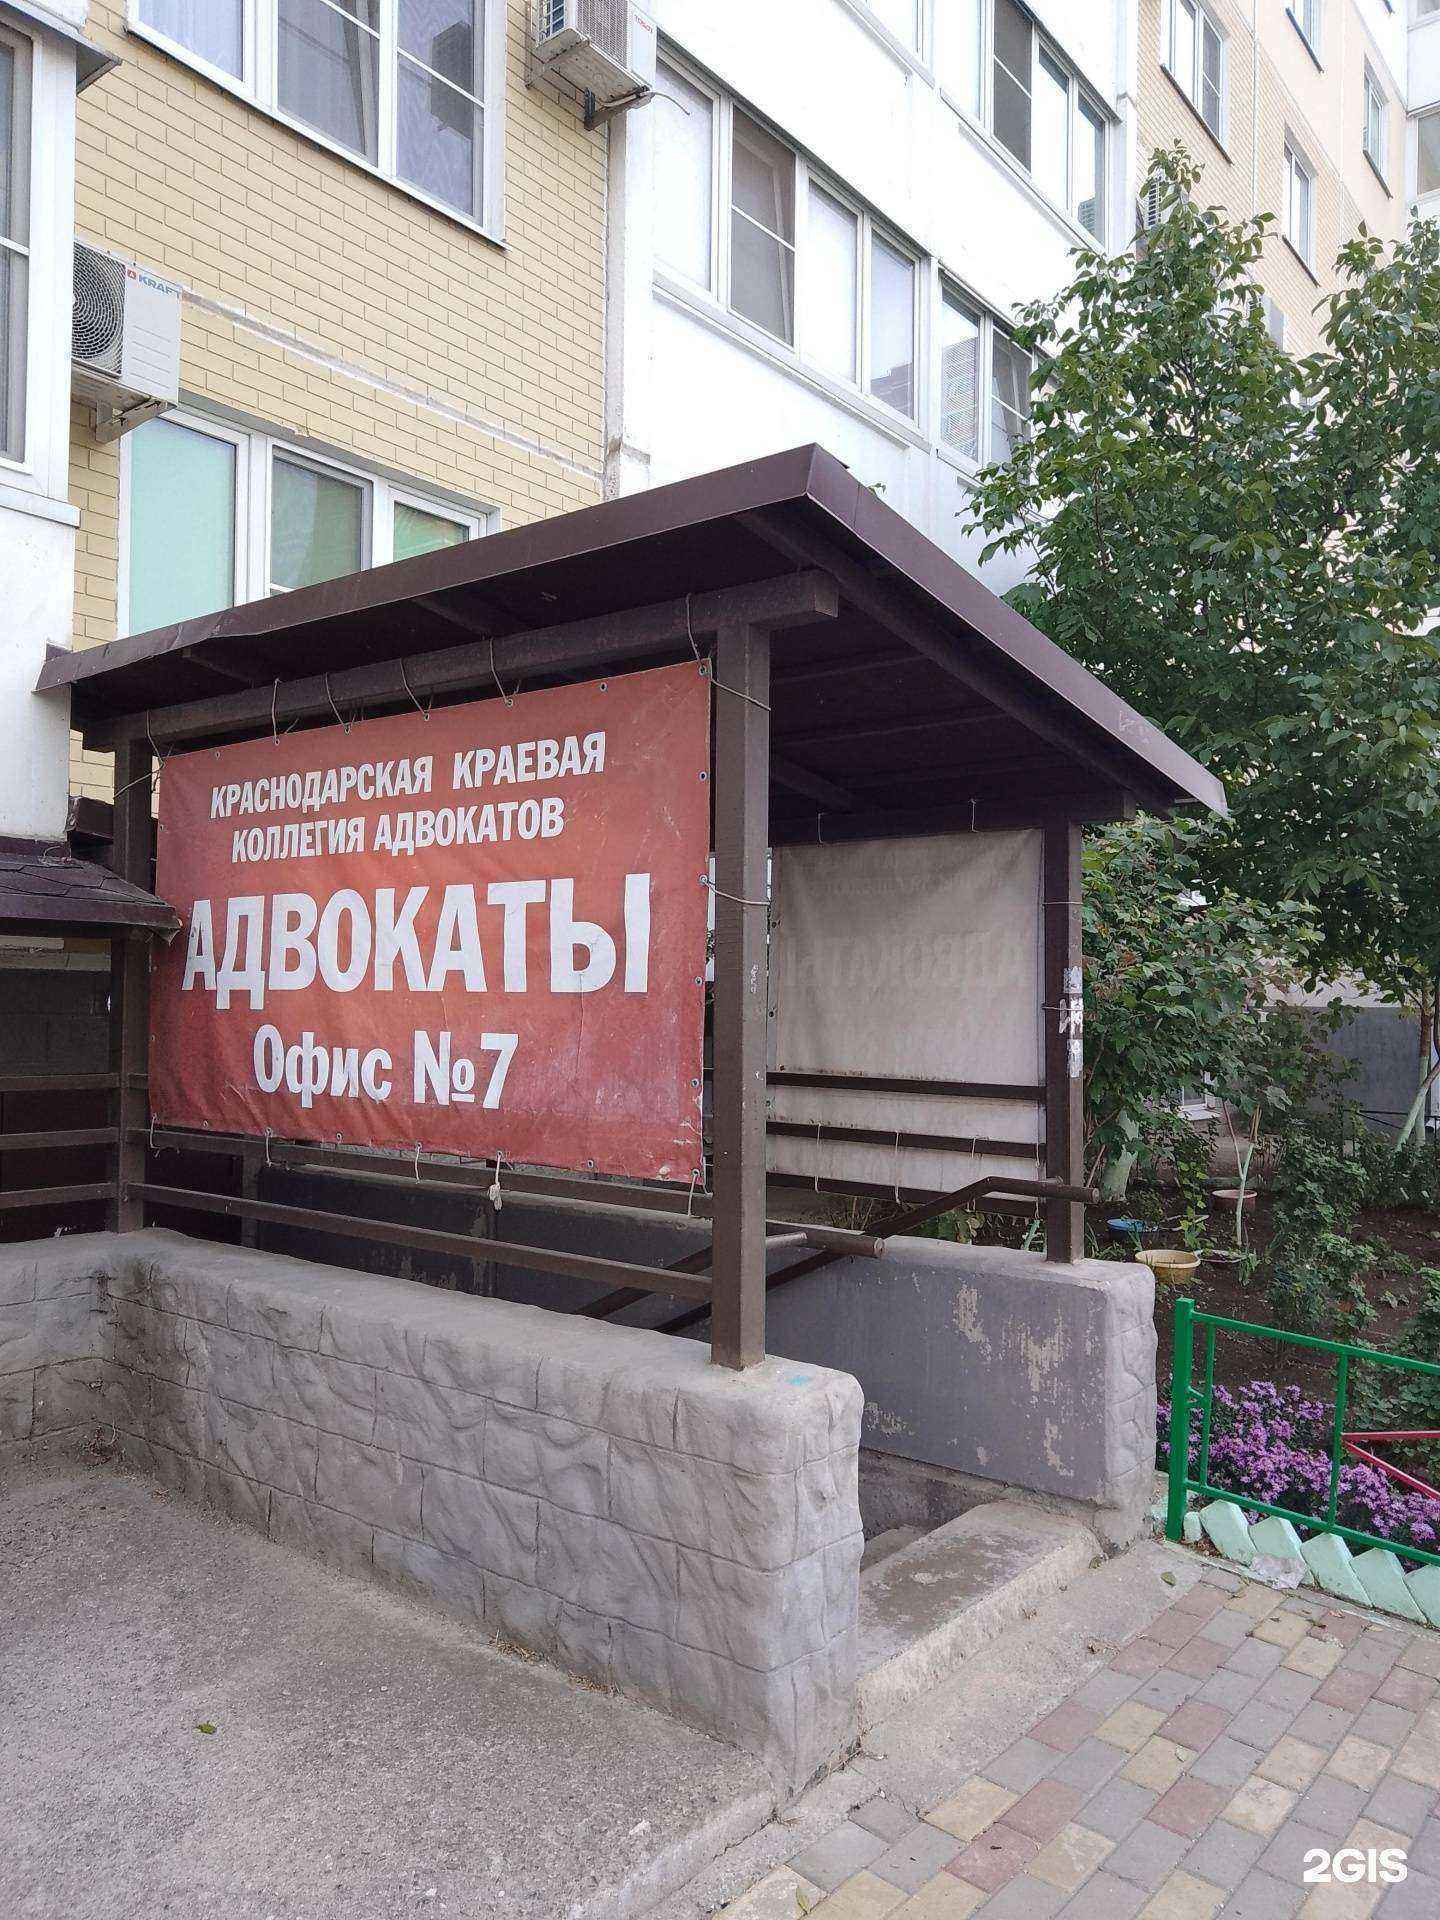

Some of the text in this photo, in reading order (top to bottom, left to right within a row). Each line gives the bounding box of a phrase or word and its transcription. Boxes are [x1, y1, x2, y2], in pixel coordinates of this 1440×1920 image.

[138, 273, 181, 299] KRAFT
[210, 731, 607, 820] КРАСНОДАРСКАЯ КРАЕВАЯ
[231, 797, 566, 864] КОЛЛЕГИЯ АДВОКАТОВ
[181, 872, 651, 1011] АДВОКАТЫ
[253, 1023, 393, 1109] Офис
